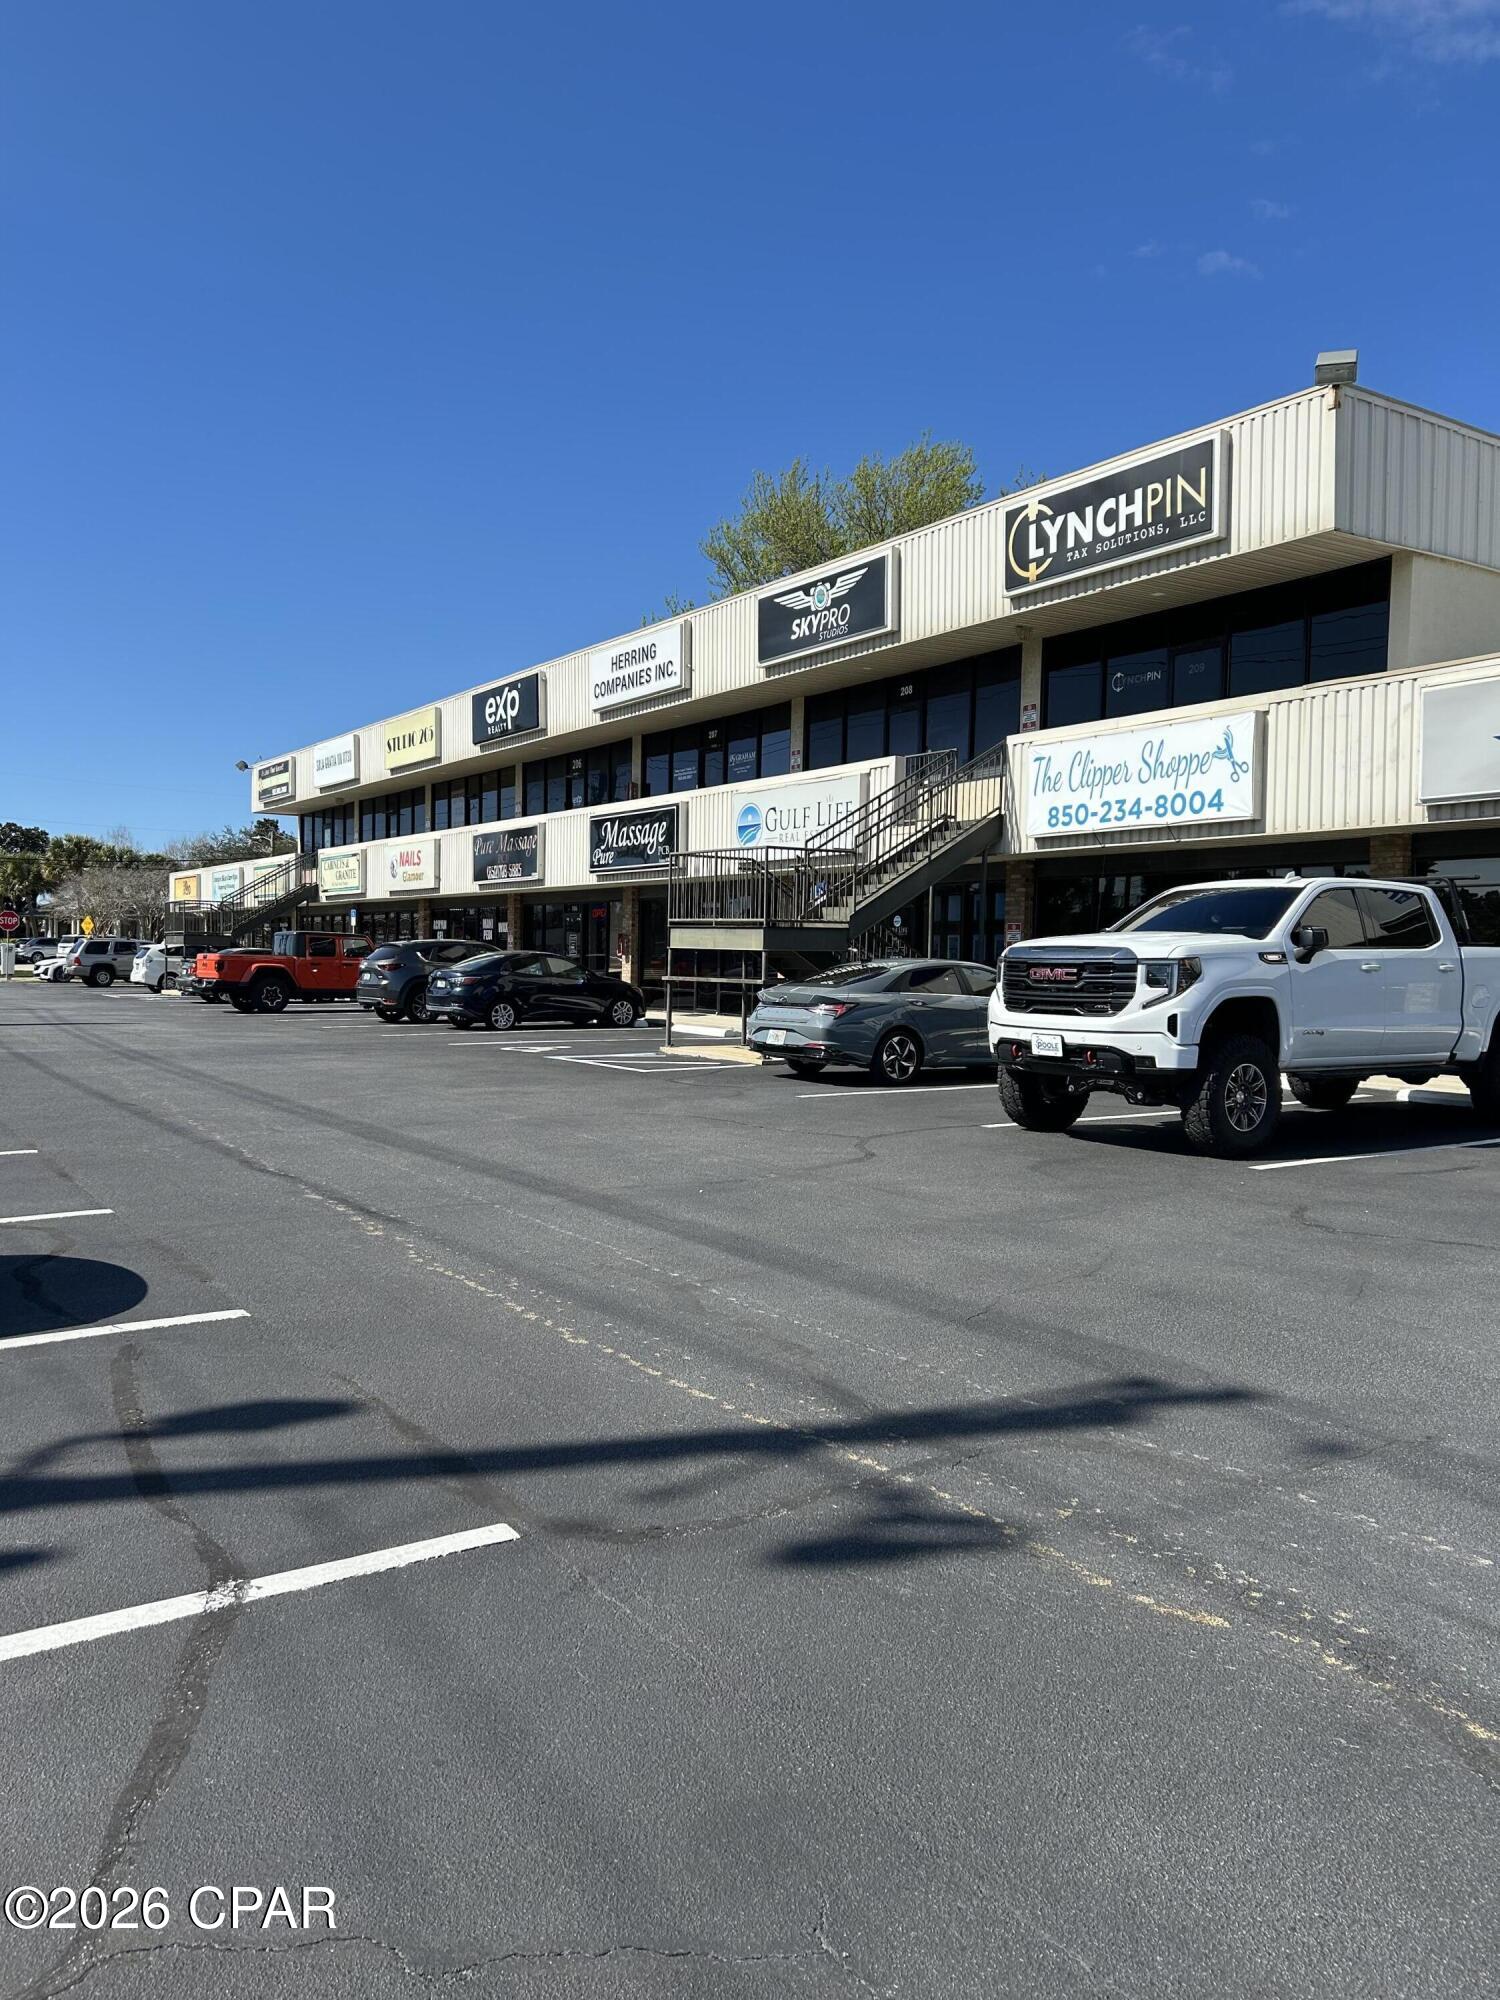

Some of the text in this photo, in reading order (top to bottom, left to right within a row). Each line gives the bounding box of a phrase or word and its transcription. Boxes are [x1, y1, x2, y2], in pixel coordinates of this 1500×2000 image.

[1028, 467, 1206, 560] LYNCHPIN
[1066, 511, 1206, 562] TAX SOLUTIONS, LLC
[790, 604, 850, 640] SKYPRO
[819, 624, 849, 640] STUDIOS
[611, 643, 657, 672] HERRING
[1189, 664, 1205, 674] 209
[594, 660, 677, 699] COMPANIES INC.
[901, 685, 913, 696] 208
[488, 723, 507, 734] REALTY
[1034, 739, 1210, 799] The Clipper Shoppe
[1048, 789, 1224, 828] 850-234-8004
[496, 834, 537, 857] Massage
[601, 820, 667, 854] Massage
[779, 832, 800, 843] REAL
[400, 850, 421, 867] NAILS
[593, 848, 614, 865] Pure
[1030, 968, 1077, 980] GMC
